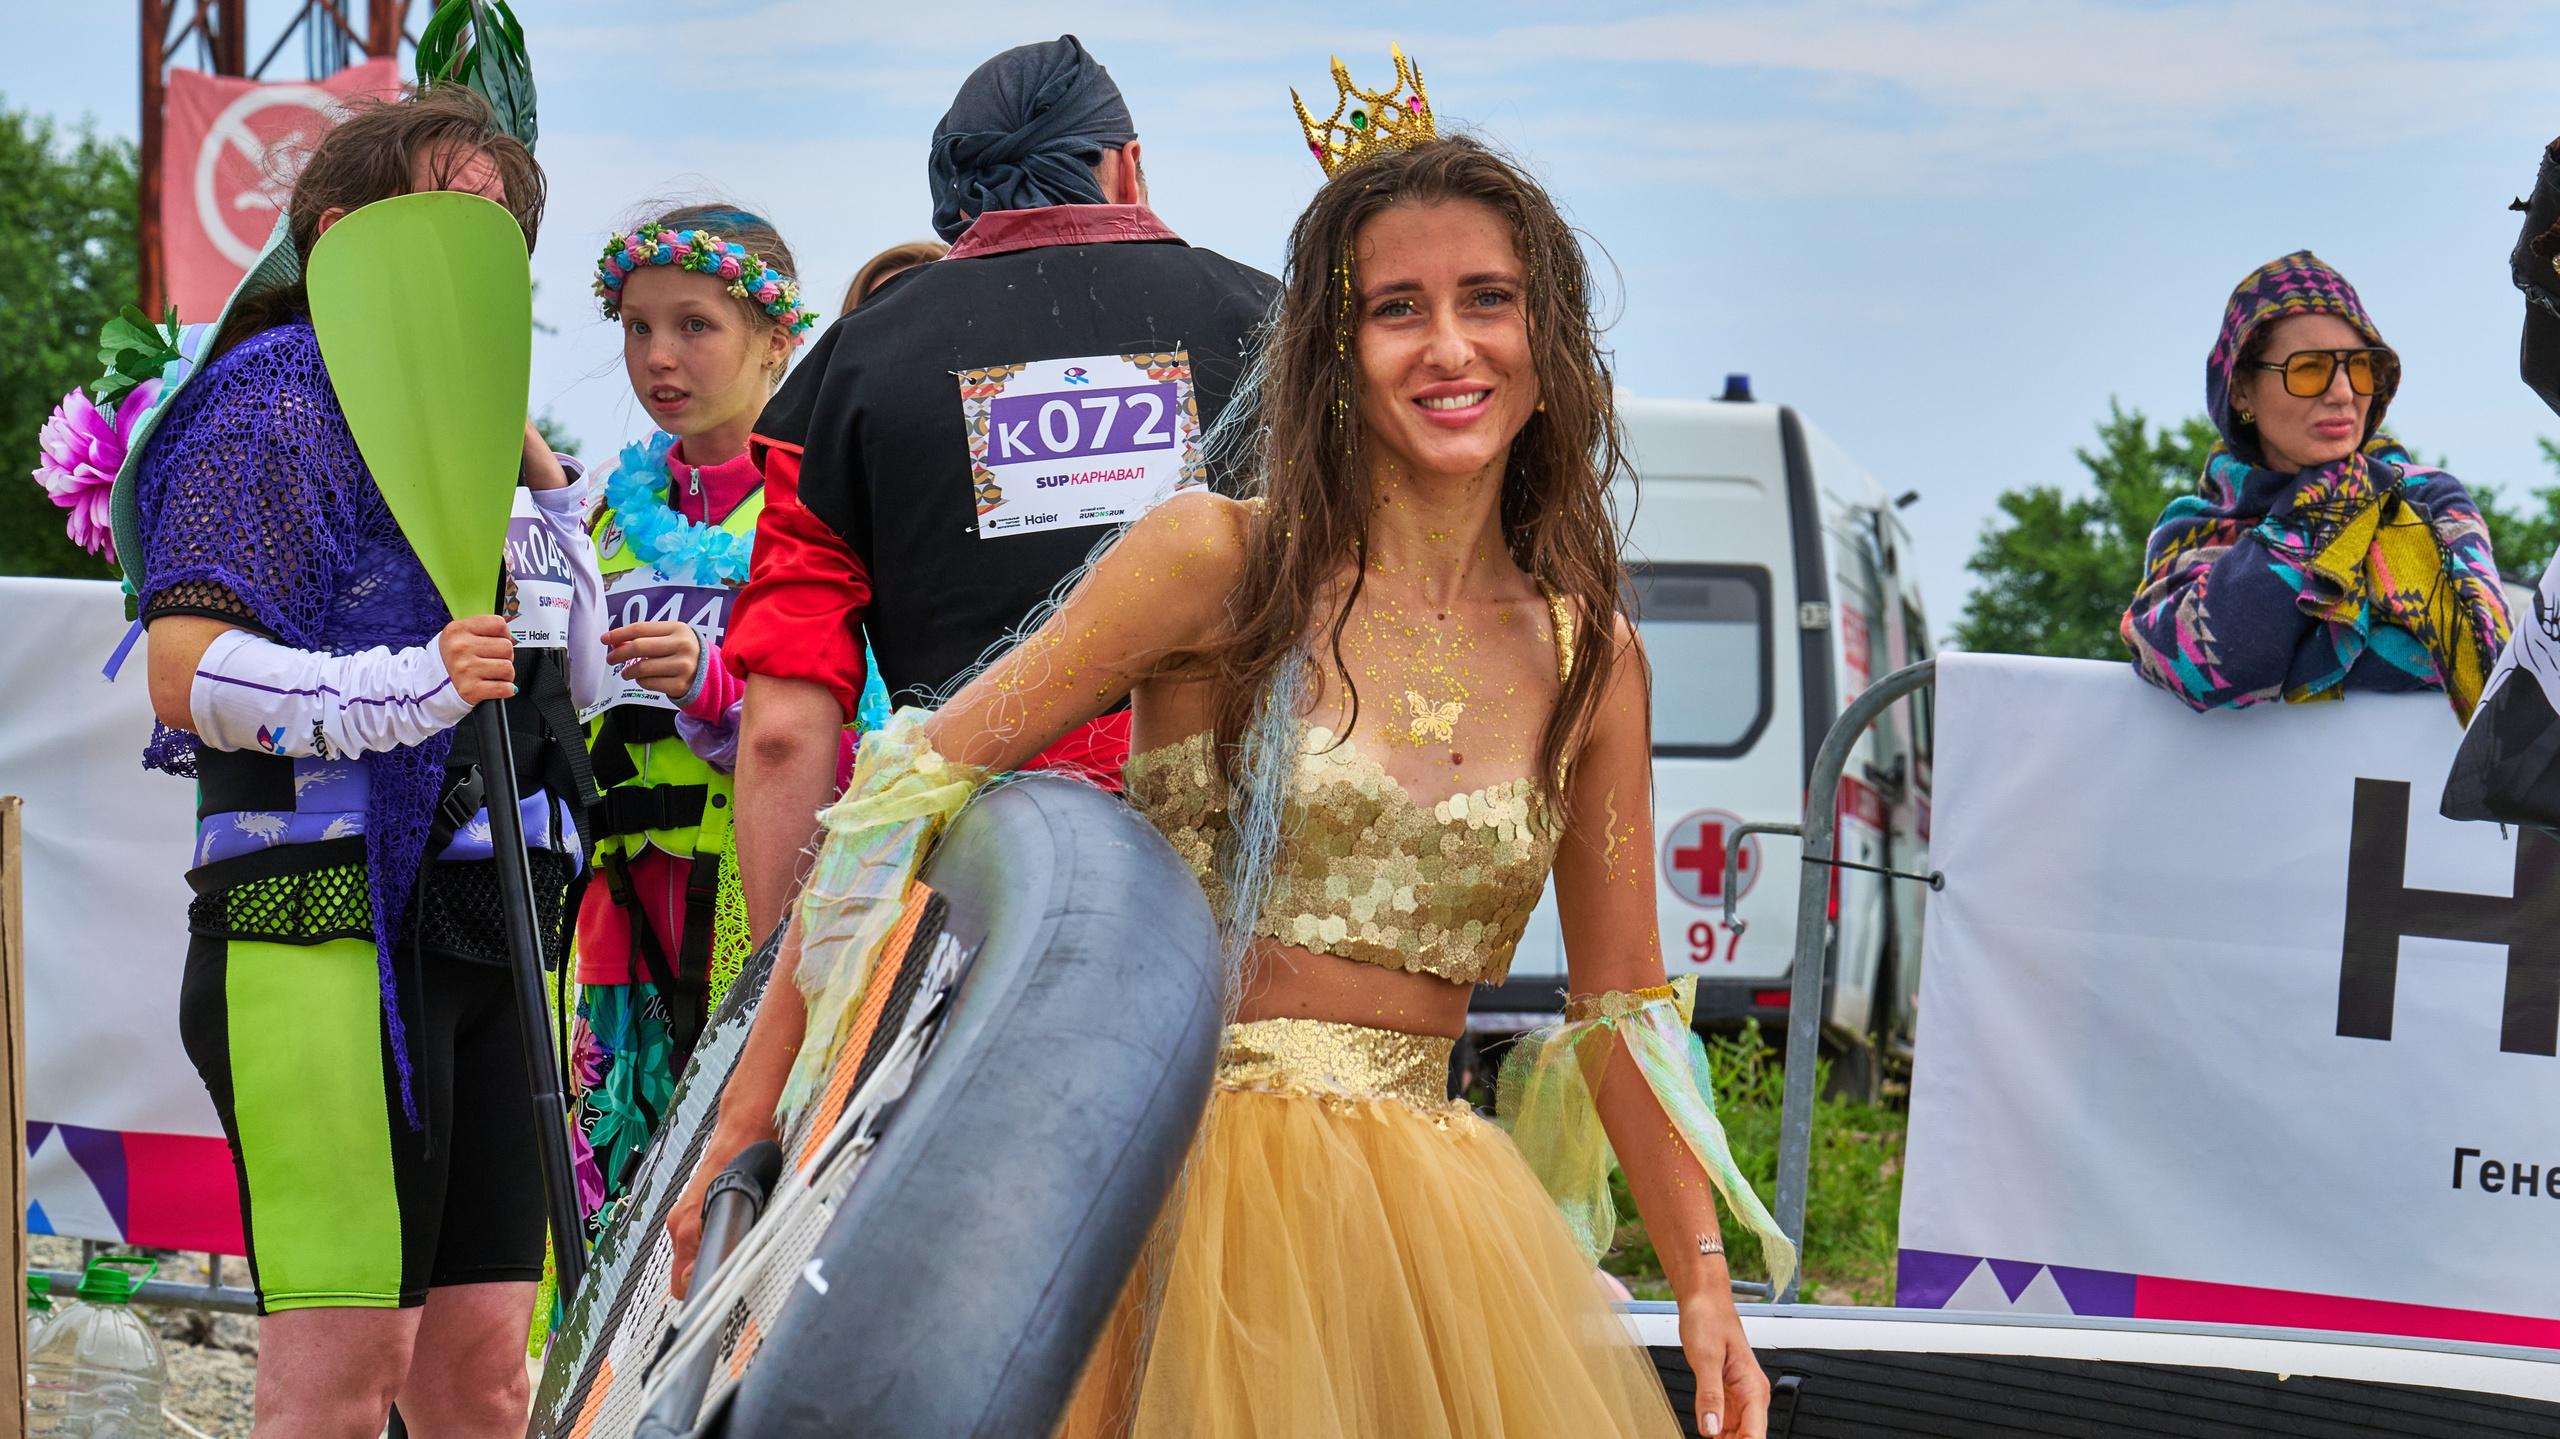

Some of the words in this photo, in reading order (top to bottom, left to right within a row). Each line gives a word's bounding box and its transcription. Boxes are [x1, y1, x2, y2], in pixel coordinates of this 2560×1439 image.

[1025, 513, 1058, 525] Haier
[529, 630, 550, 640] Haier
[1687, 921, 1747, 963] 97
[2452, 1147, 2560, 1200] Гене
